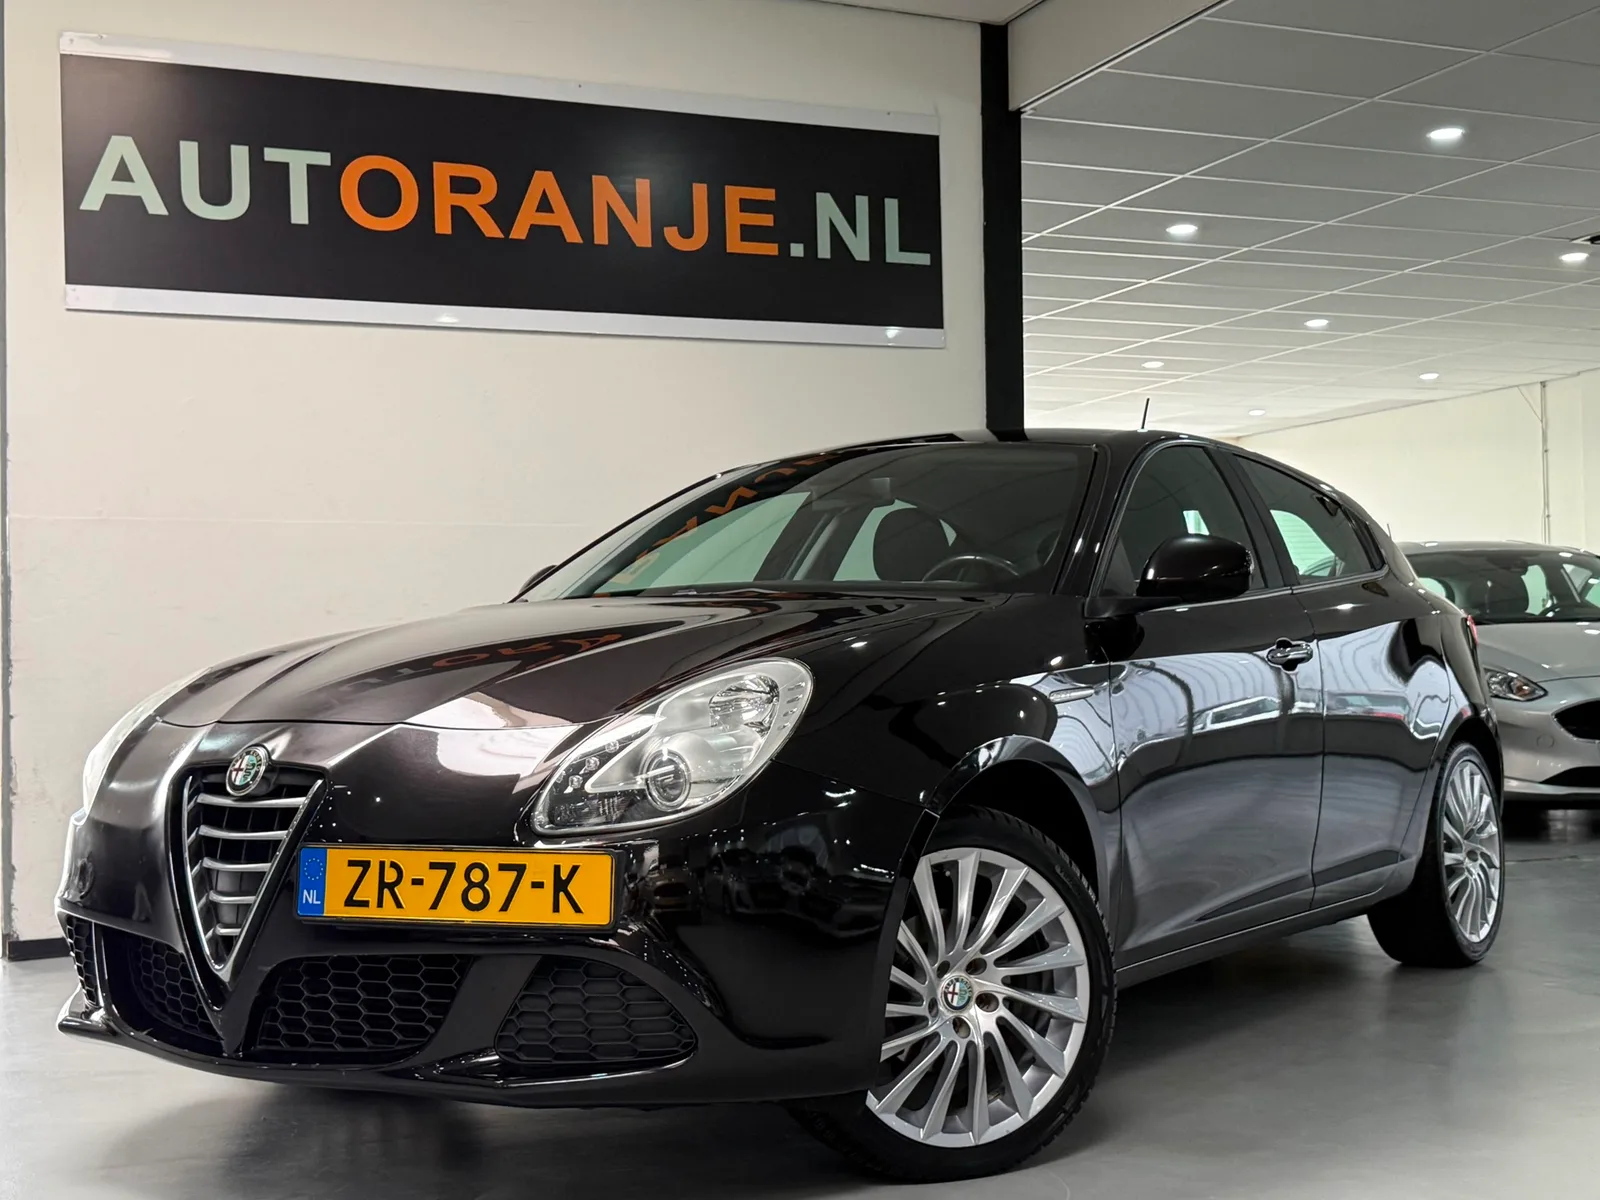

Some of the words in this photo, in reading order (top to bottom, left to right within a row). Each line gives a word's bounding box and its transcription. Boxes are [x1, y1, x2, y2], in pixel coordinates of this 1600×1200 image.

[79, 134, 931, 266] AUTORANJE.NL
[302, 889, 321, 905] NL
[343, 859, 584, 914] ZR-787-K
